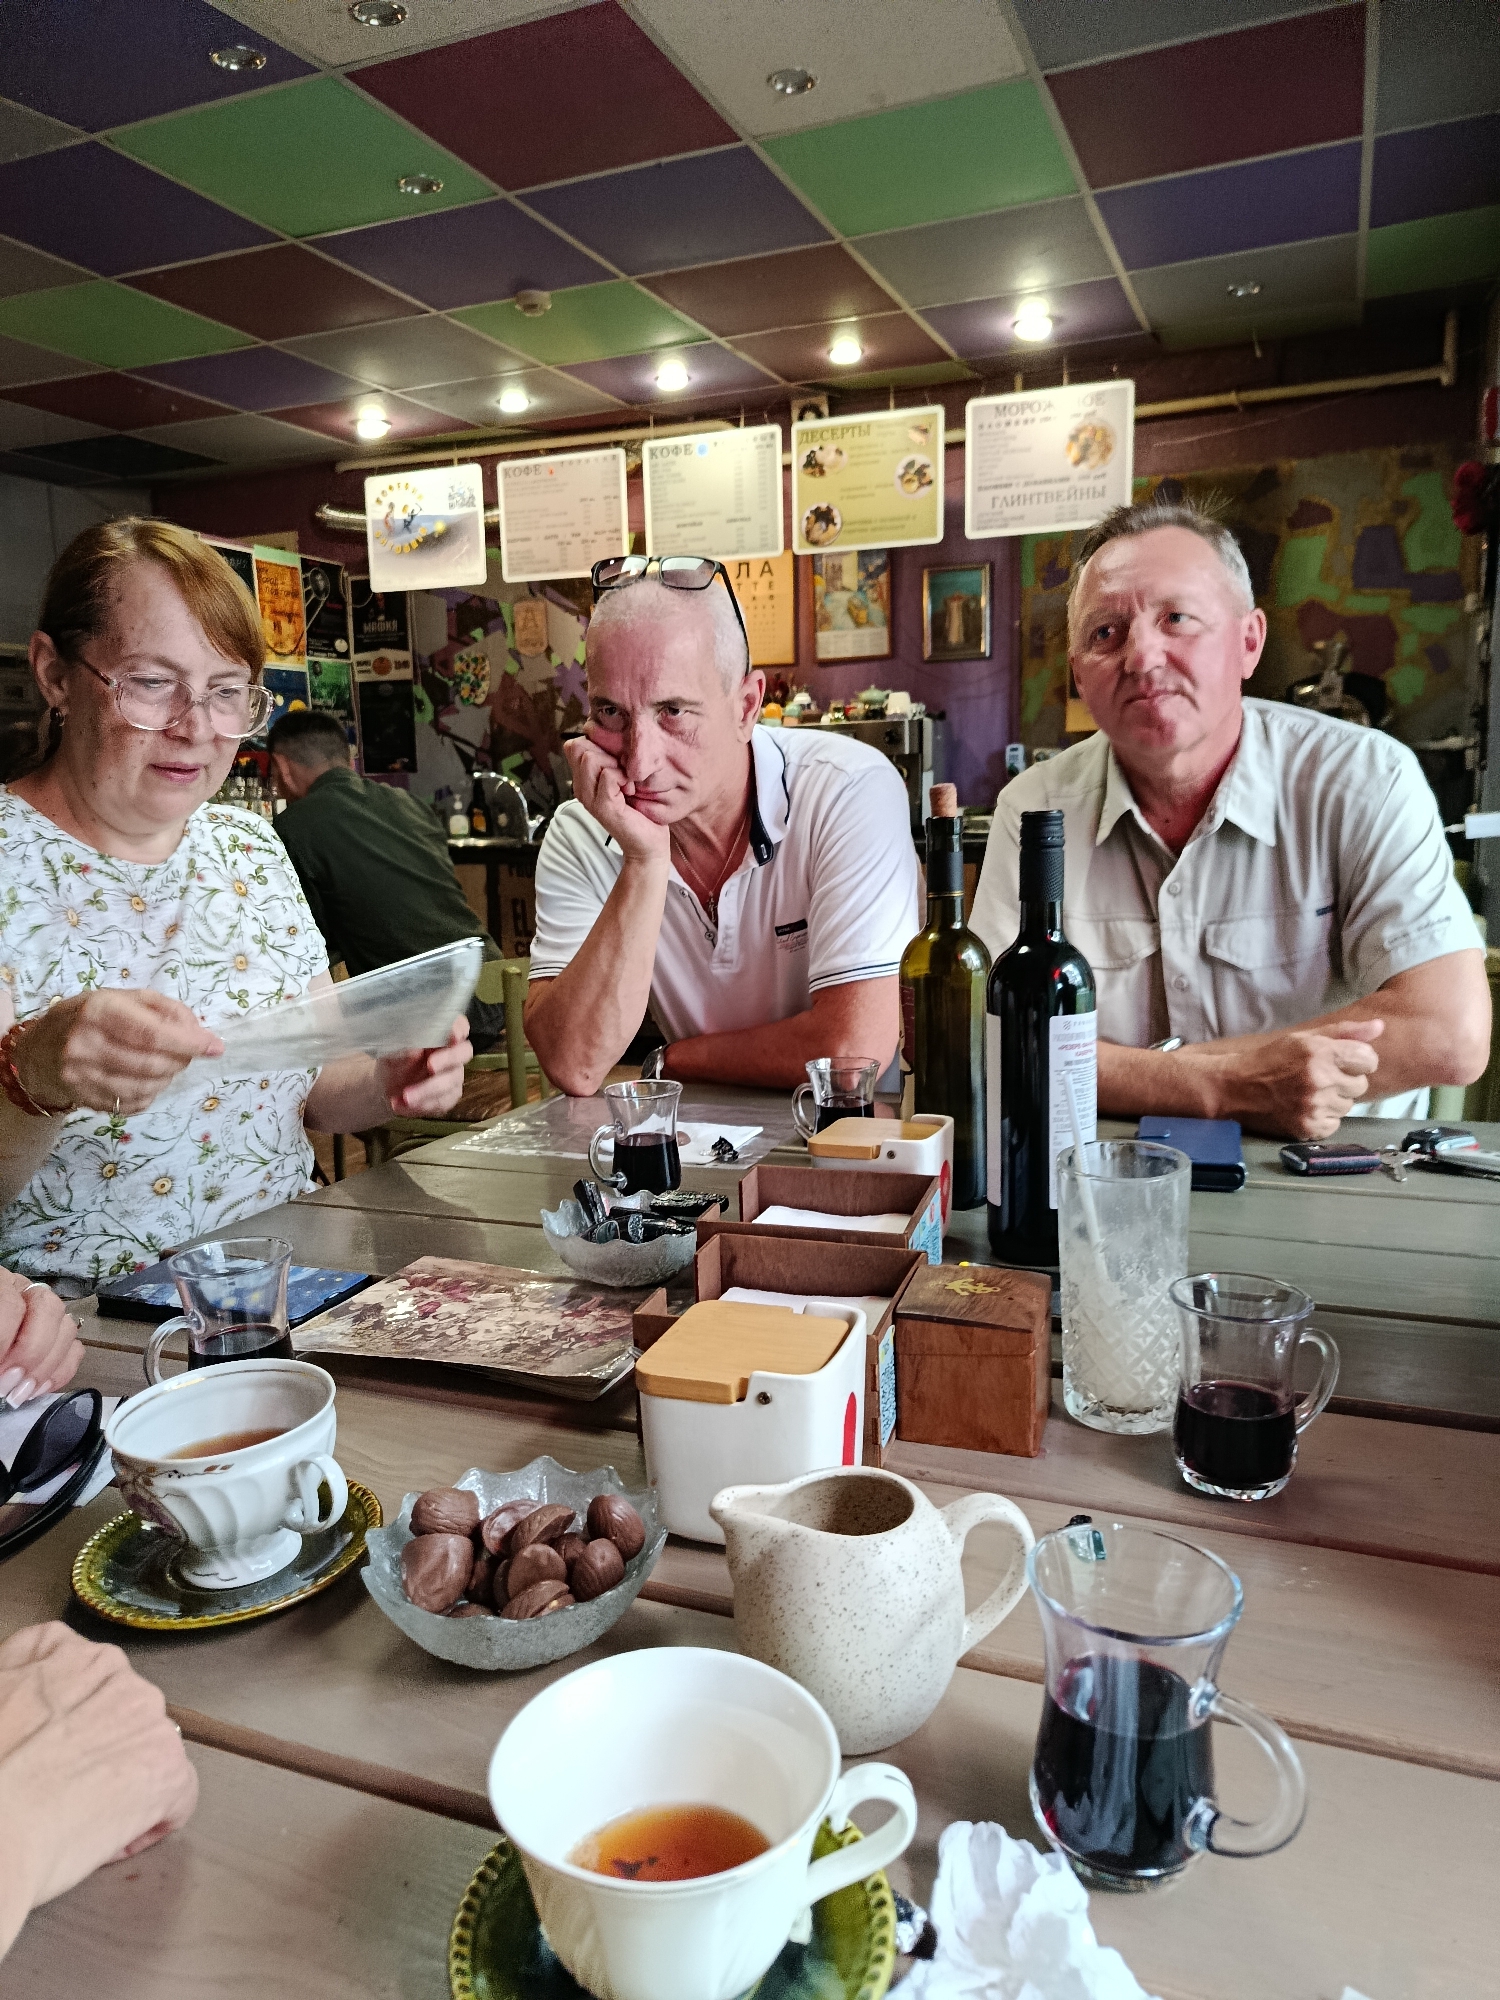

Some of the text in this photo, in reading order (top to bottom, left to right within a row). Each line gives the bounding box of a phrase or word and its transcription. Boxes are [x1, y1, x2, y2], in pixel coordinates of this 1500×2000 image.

[800, 424, 872, 445] ДЕСЕРТЫ
[650, 443, 694, 460] КОФЕ
[504, 464, 542, 478] КОФЕ
[991, 484, 1107, 509] ГЛИНТВЕЙНЫ
